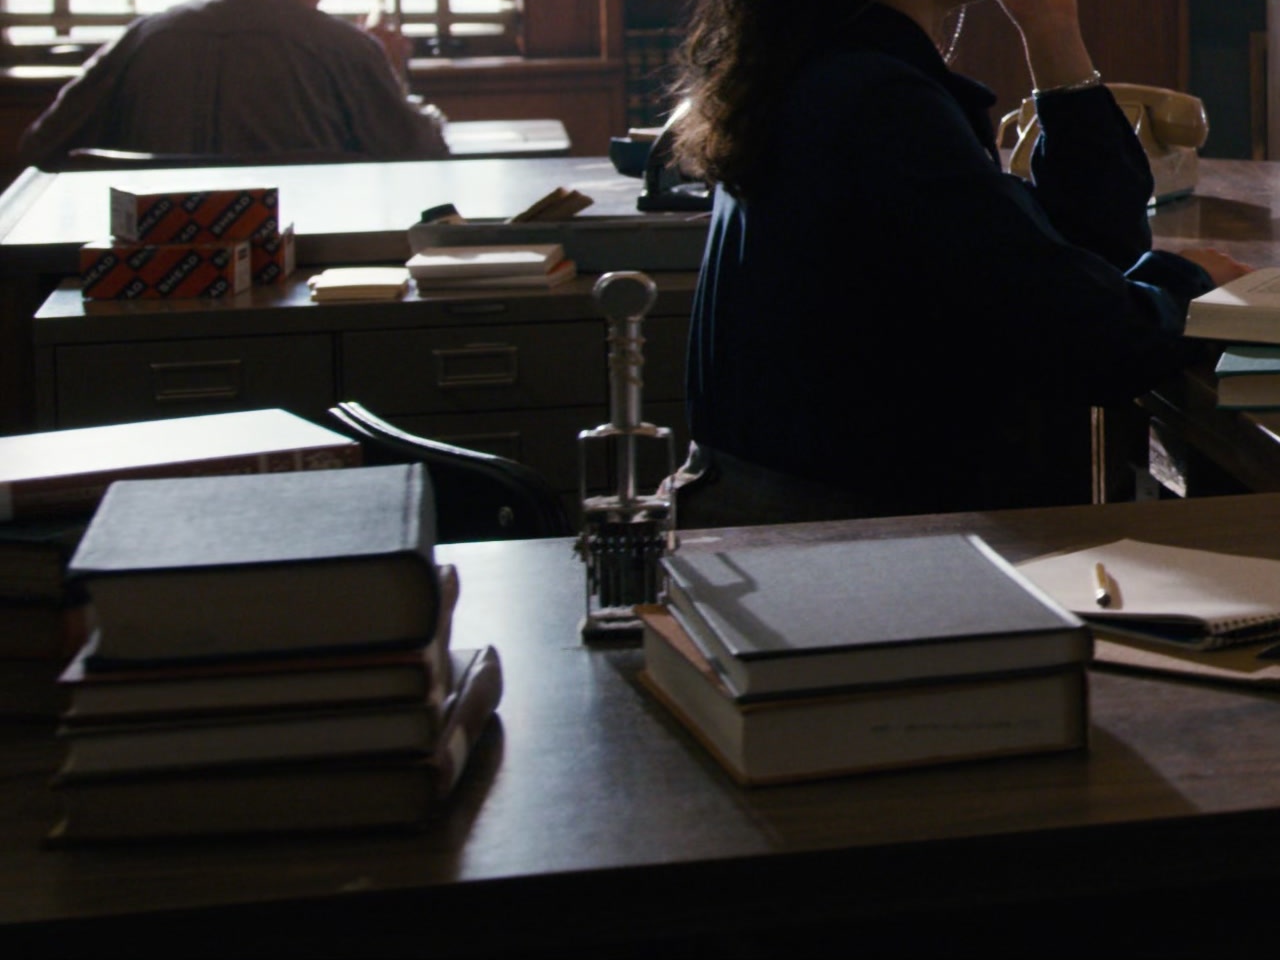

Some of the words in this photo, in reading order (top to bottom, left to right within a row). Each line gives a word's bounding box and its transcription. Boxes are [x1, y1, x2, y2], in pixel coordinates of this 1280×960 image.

[138, 200, 170, 236] MEAD
[211, 196, 250, 235] SMEAD
[83, 256, 114, 287] MEAD
[157, 254, 199, 292] SMEAD
